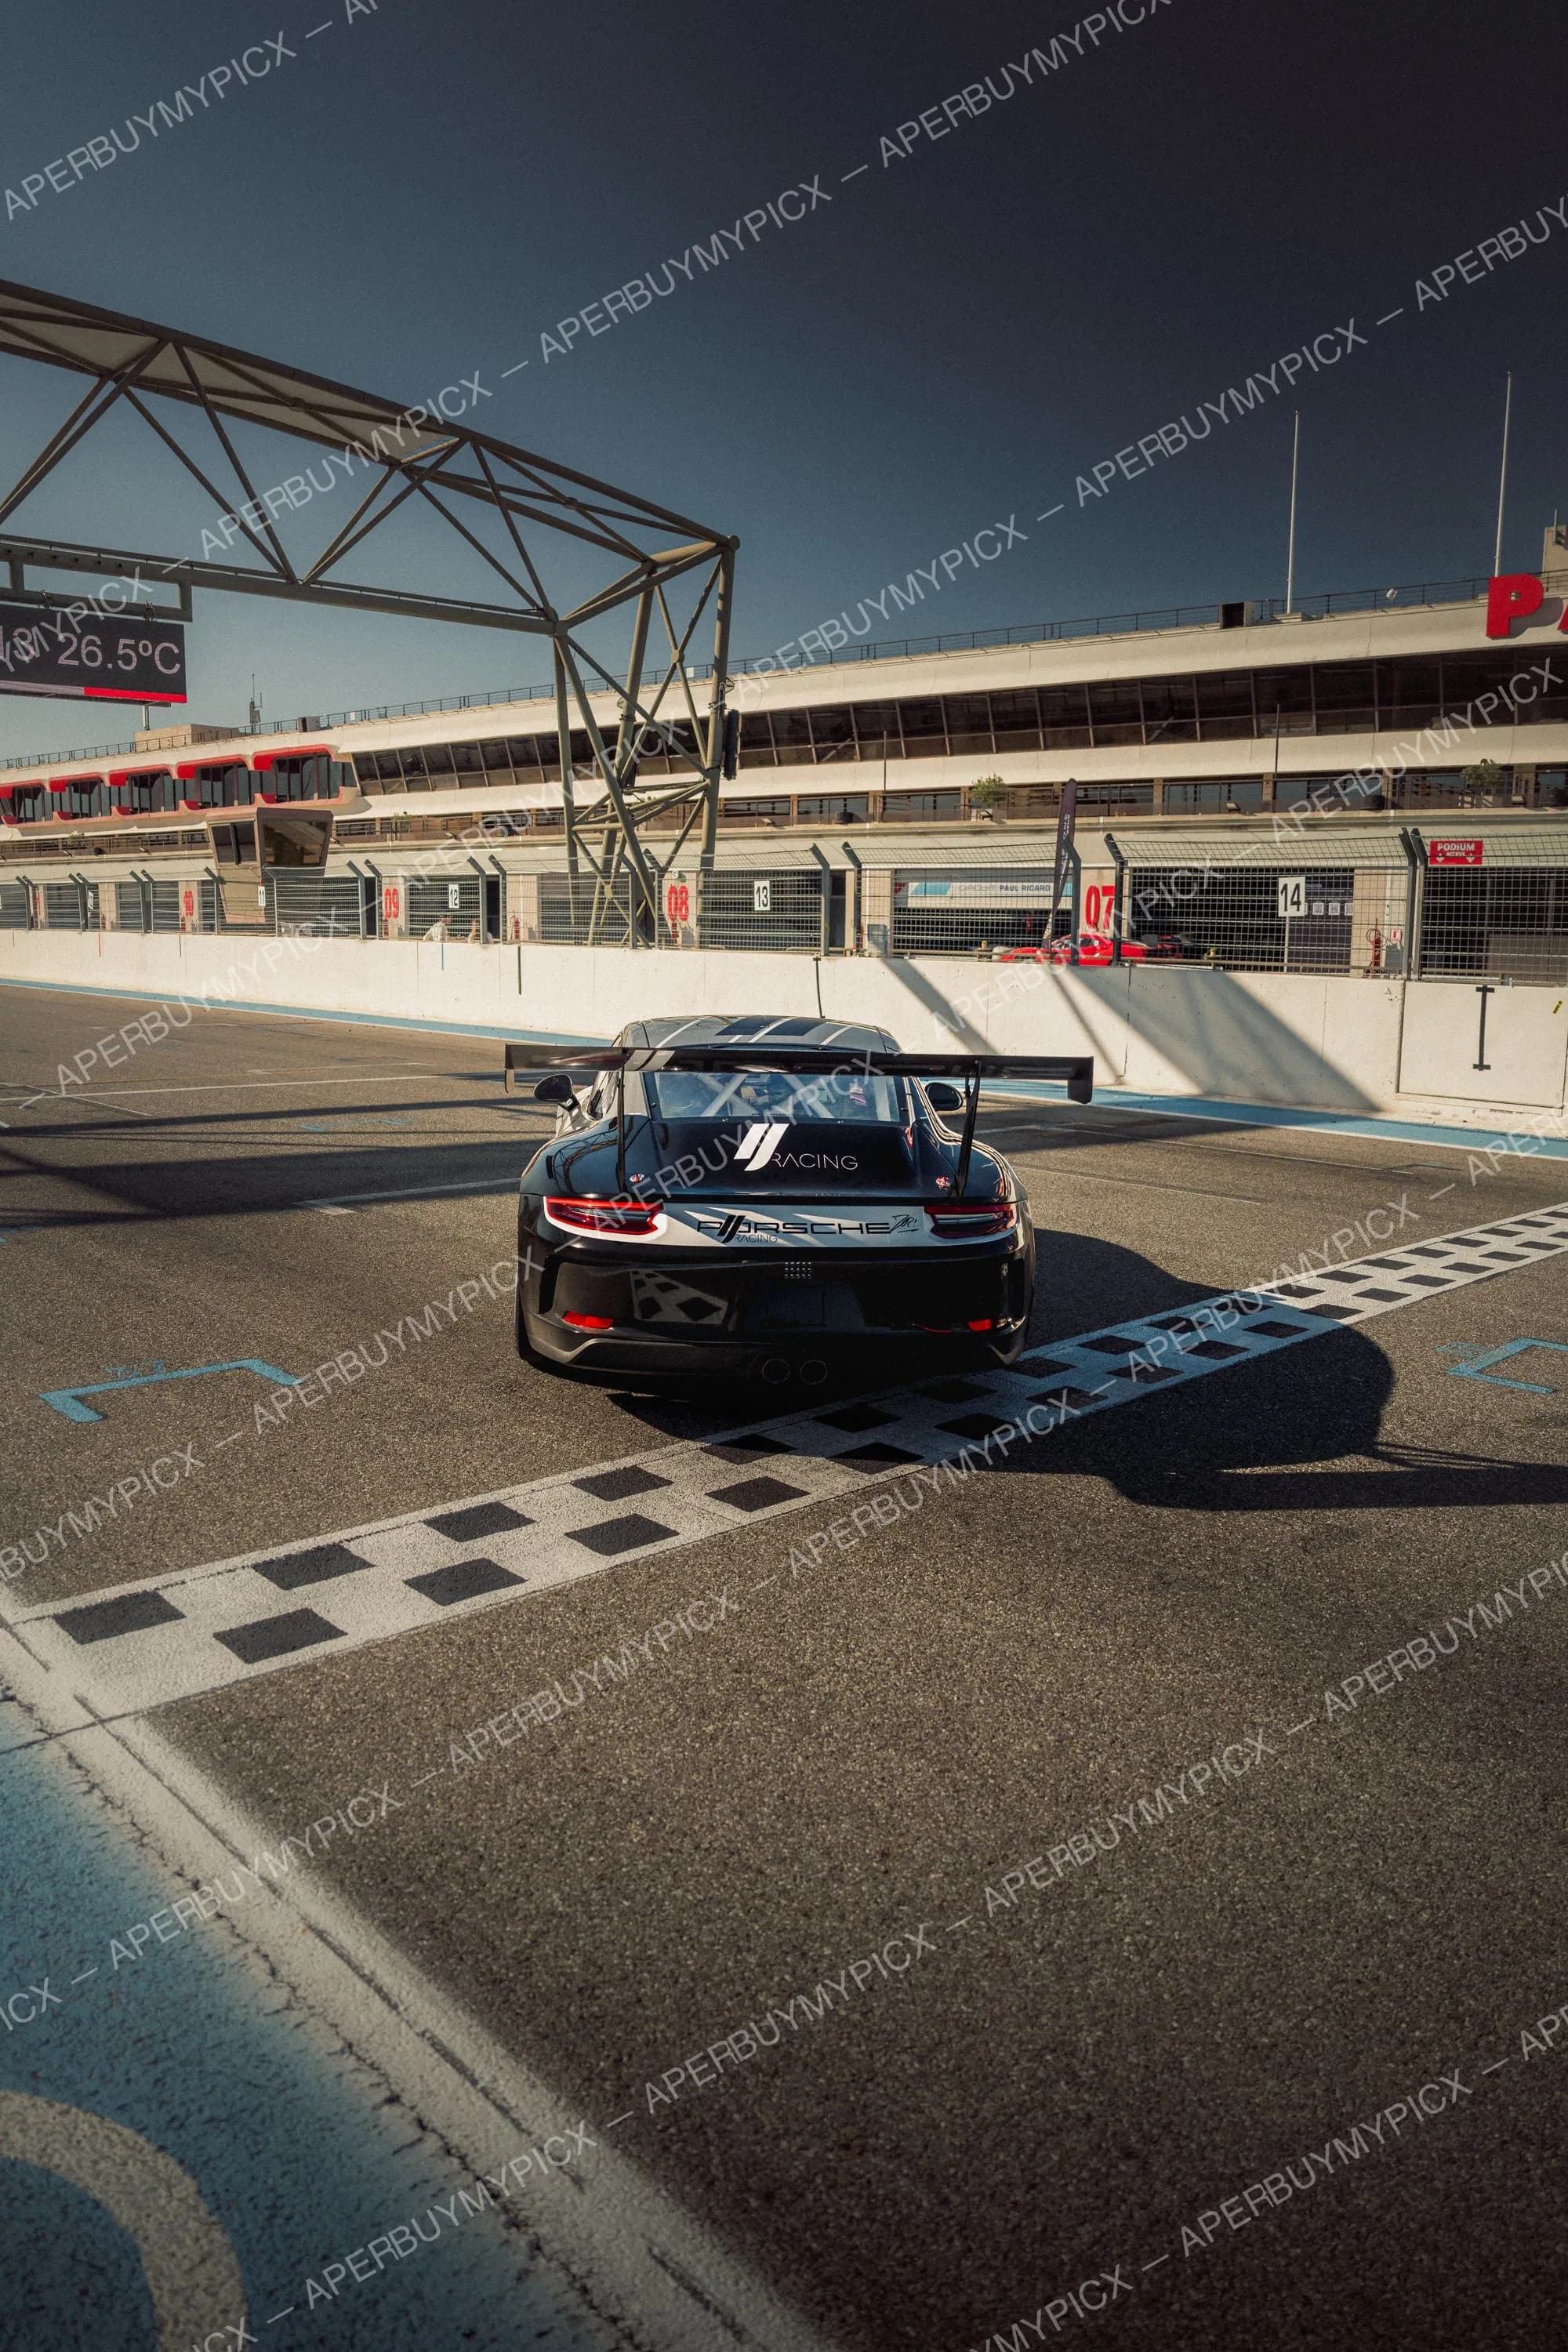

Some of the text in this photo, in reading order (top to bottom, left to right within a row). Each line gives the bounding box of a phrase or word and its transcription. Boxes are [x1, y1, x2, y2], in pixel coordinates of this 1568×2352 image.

[1486, 573, 1568, 640] P
[1437, 842, 1475, 851] PODIUM
[383, 887, 400, 919] 09
[449, 888, 459, 907] 12
[667, 885, 689, 922] 08
[756, 885, 769, 908] 13
[1085, 884, 1117, 929] 07
[1279, 883, 1302, 913] 14
[771, 1152, 858, 1171] RACING
[735, 1234, 779, 1243] RACING
